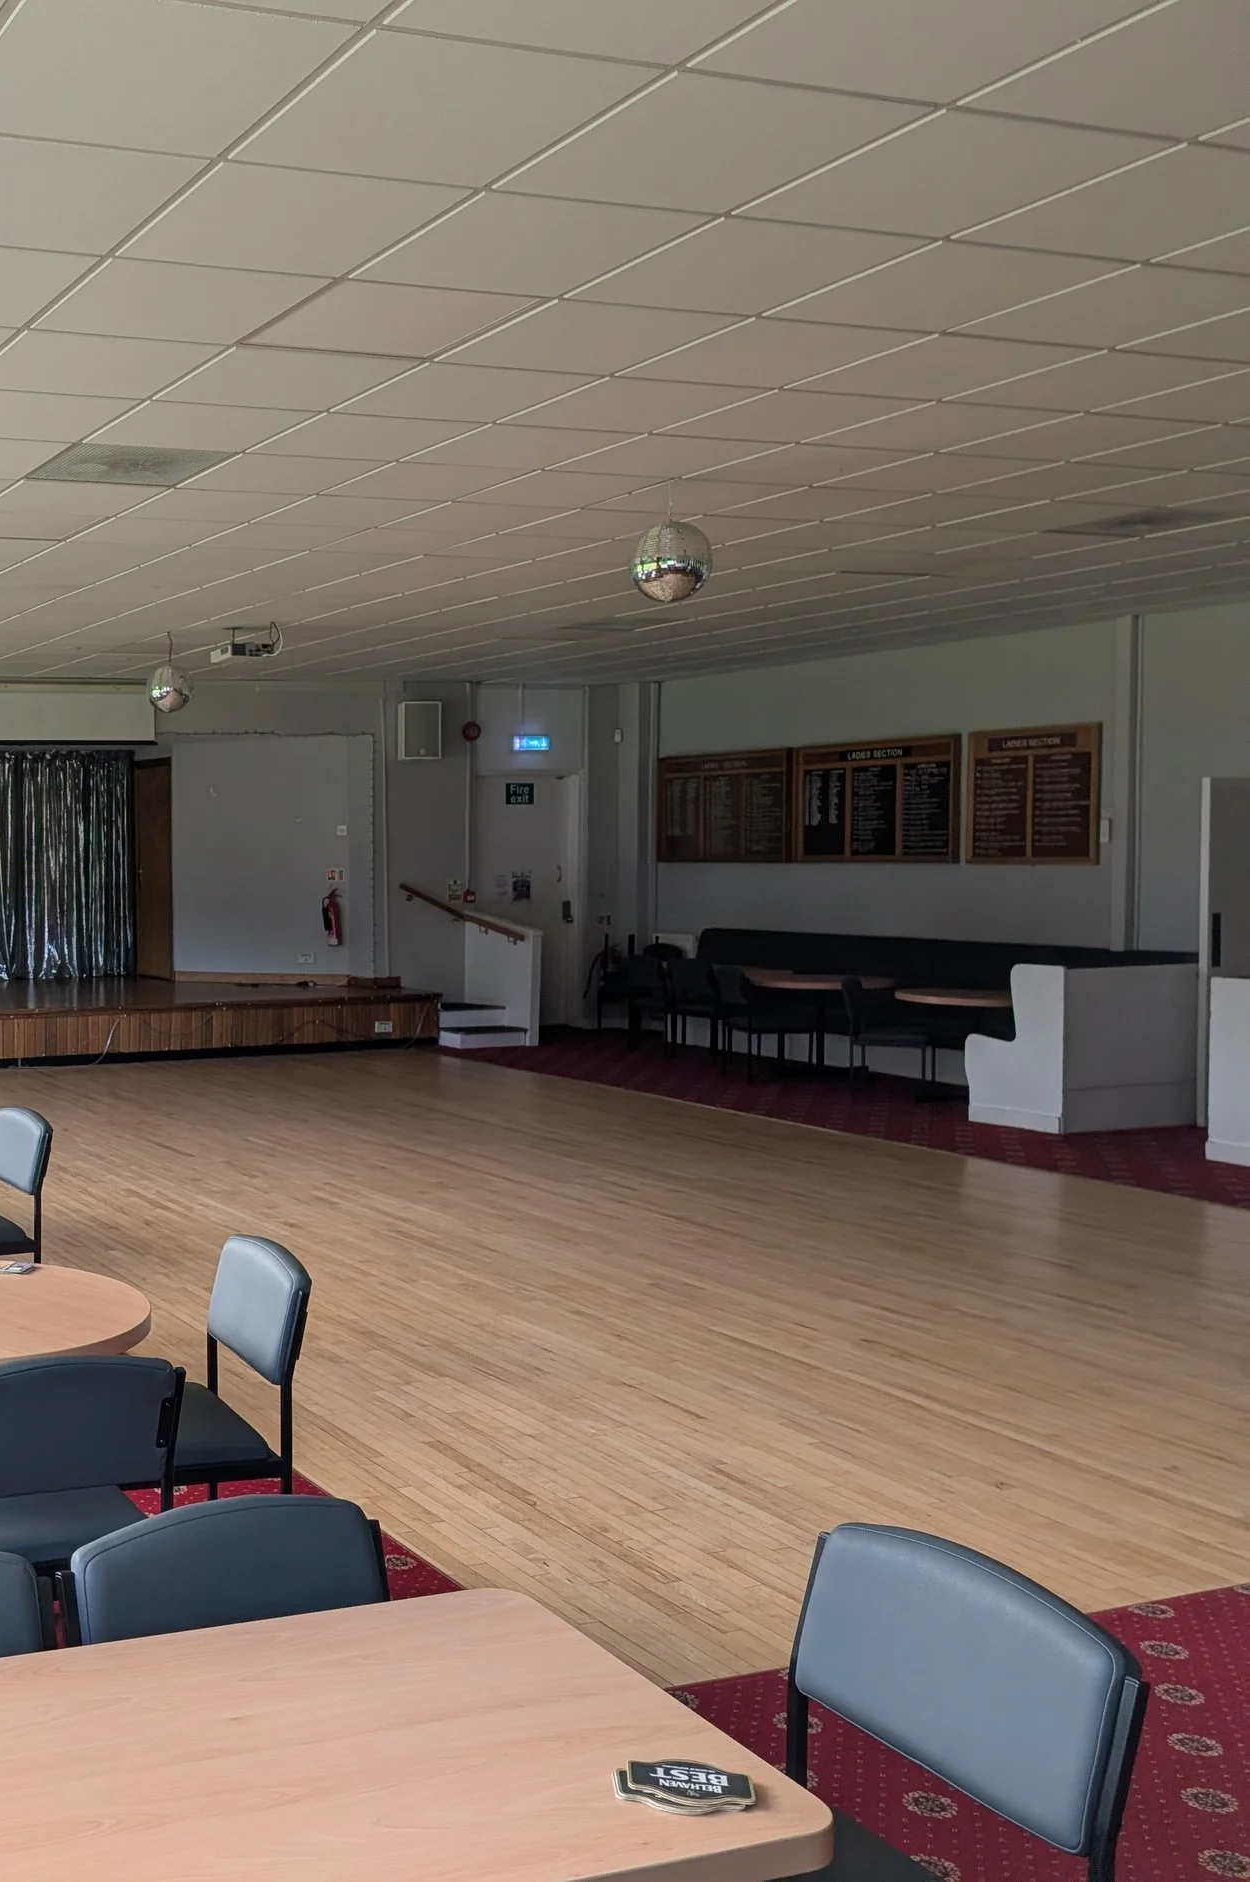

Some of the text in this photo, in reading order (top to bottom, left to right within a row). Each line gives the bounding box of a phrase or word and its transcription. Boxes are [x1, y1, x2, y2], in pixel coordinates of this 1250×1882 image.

[1002, 736, 1061, 749] LADIES SECTION
[847, 748, 903, 761] LADIES SECTION
[509, 784, 530, 794] Fire
[509, 794, 529, 803] exit
[648, 1766, 730, 1787] BEST
[659, 1778, 723, 1794] BELHAVEN
